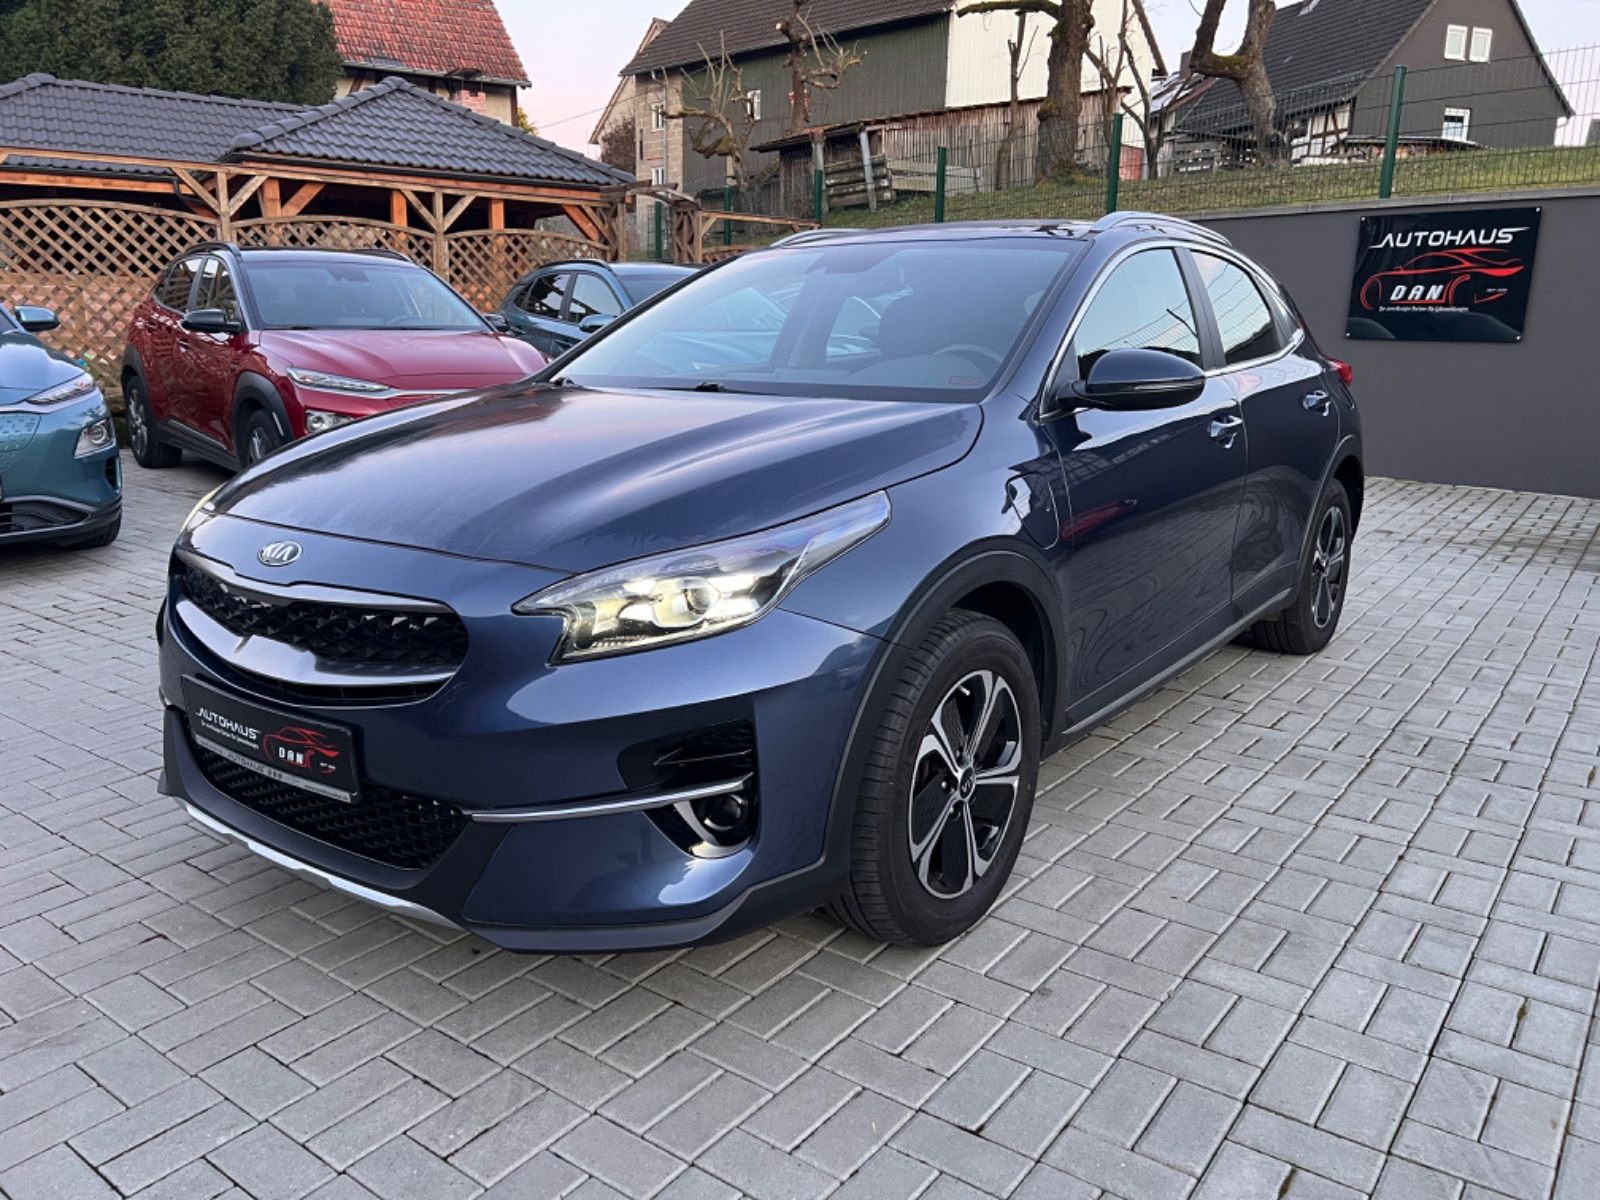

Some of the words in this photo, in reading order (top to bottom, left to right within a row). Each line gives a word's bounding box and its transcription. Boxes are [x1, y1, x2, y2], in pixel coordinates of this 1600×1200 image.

[1371, 227, 1528, 248] AUTOHAUS
[1390, 285, 1444, 300] DAN
[261, 543, 294, 561] KIA
[196, 707, 261, 740] AUTOHAUS
